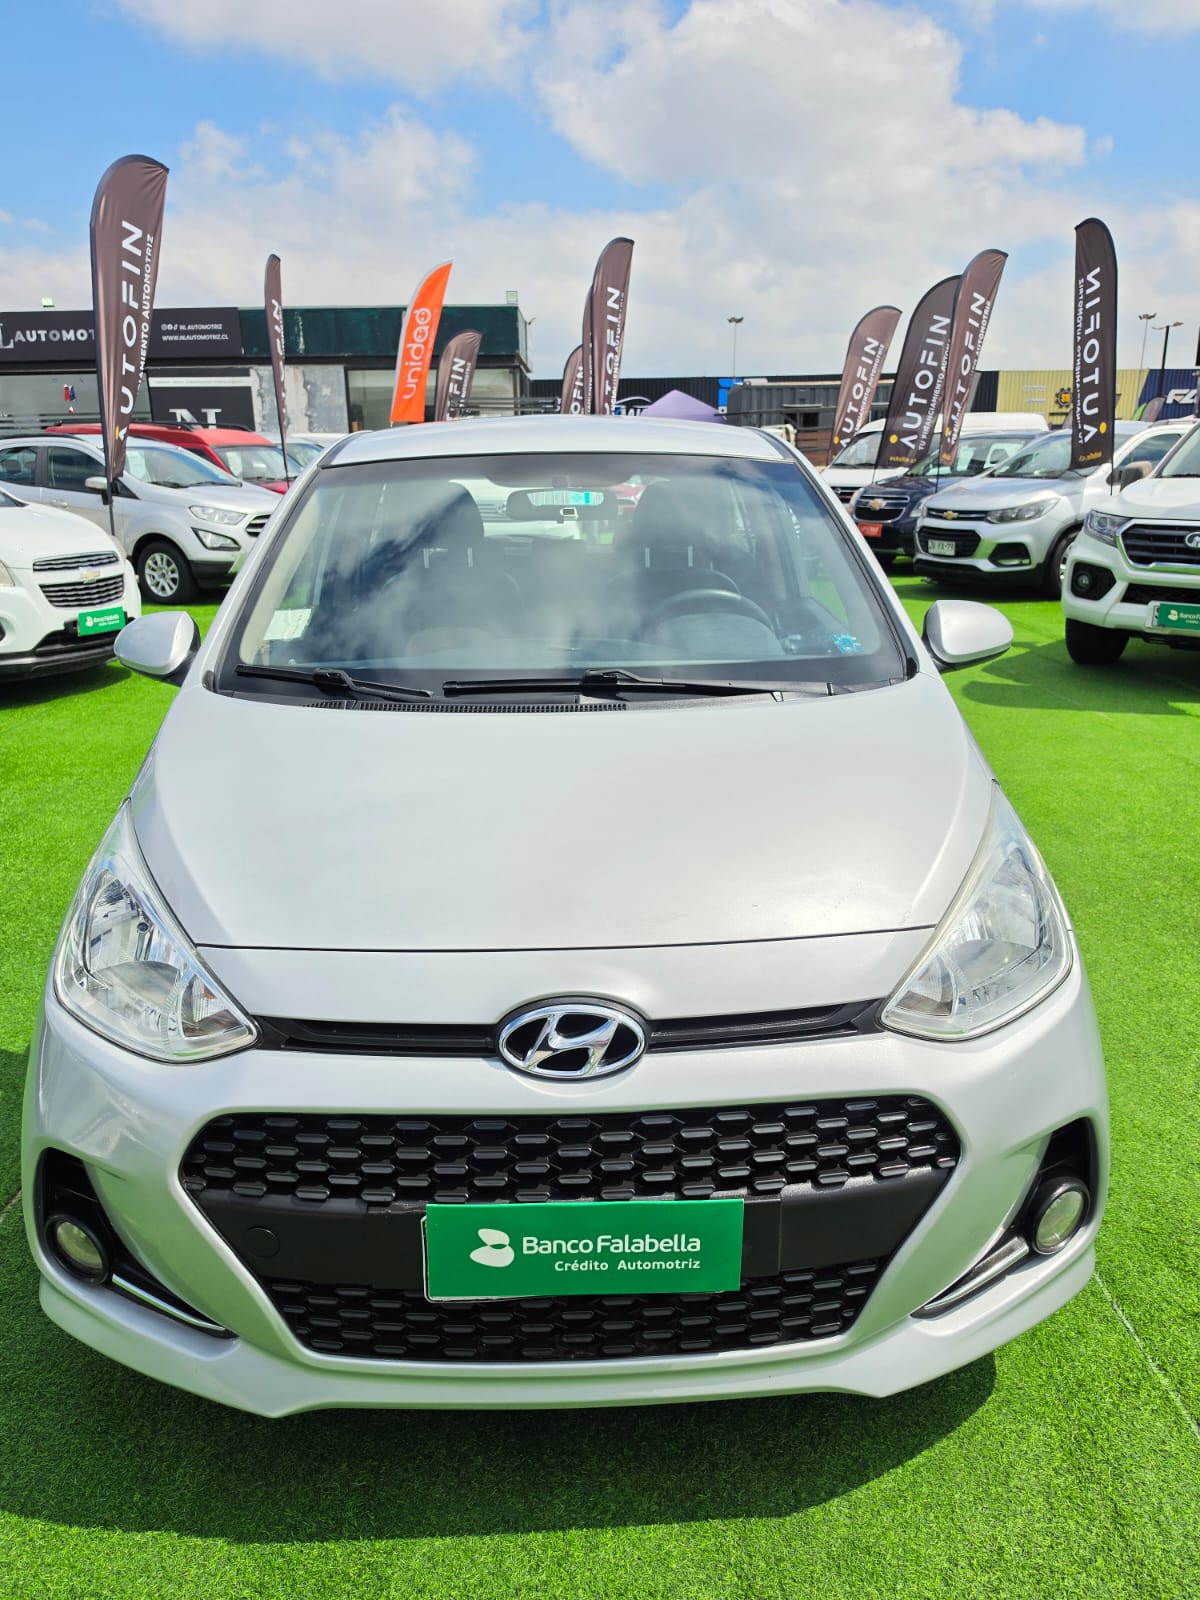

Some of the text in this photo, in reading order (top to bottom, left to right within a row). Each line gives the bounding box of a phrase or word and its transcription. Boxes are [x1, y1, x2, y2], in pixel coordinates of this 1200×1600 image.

[142, 234, 154, 319] AUTOMOTRIZ
[403, 308, 431, 399] unidad
[840, 337, 880, 448] AUTOFIN
[900, 314, 951, 450] AUTOFIN
[522, 1233, 701, 1255] Banco Falabella
[554, 1258, 701, 1272] Crédito Automotriz
